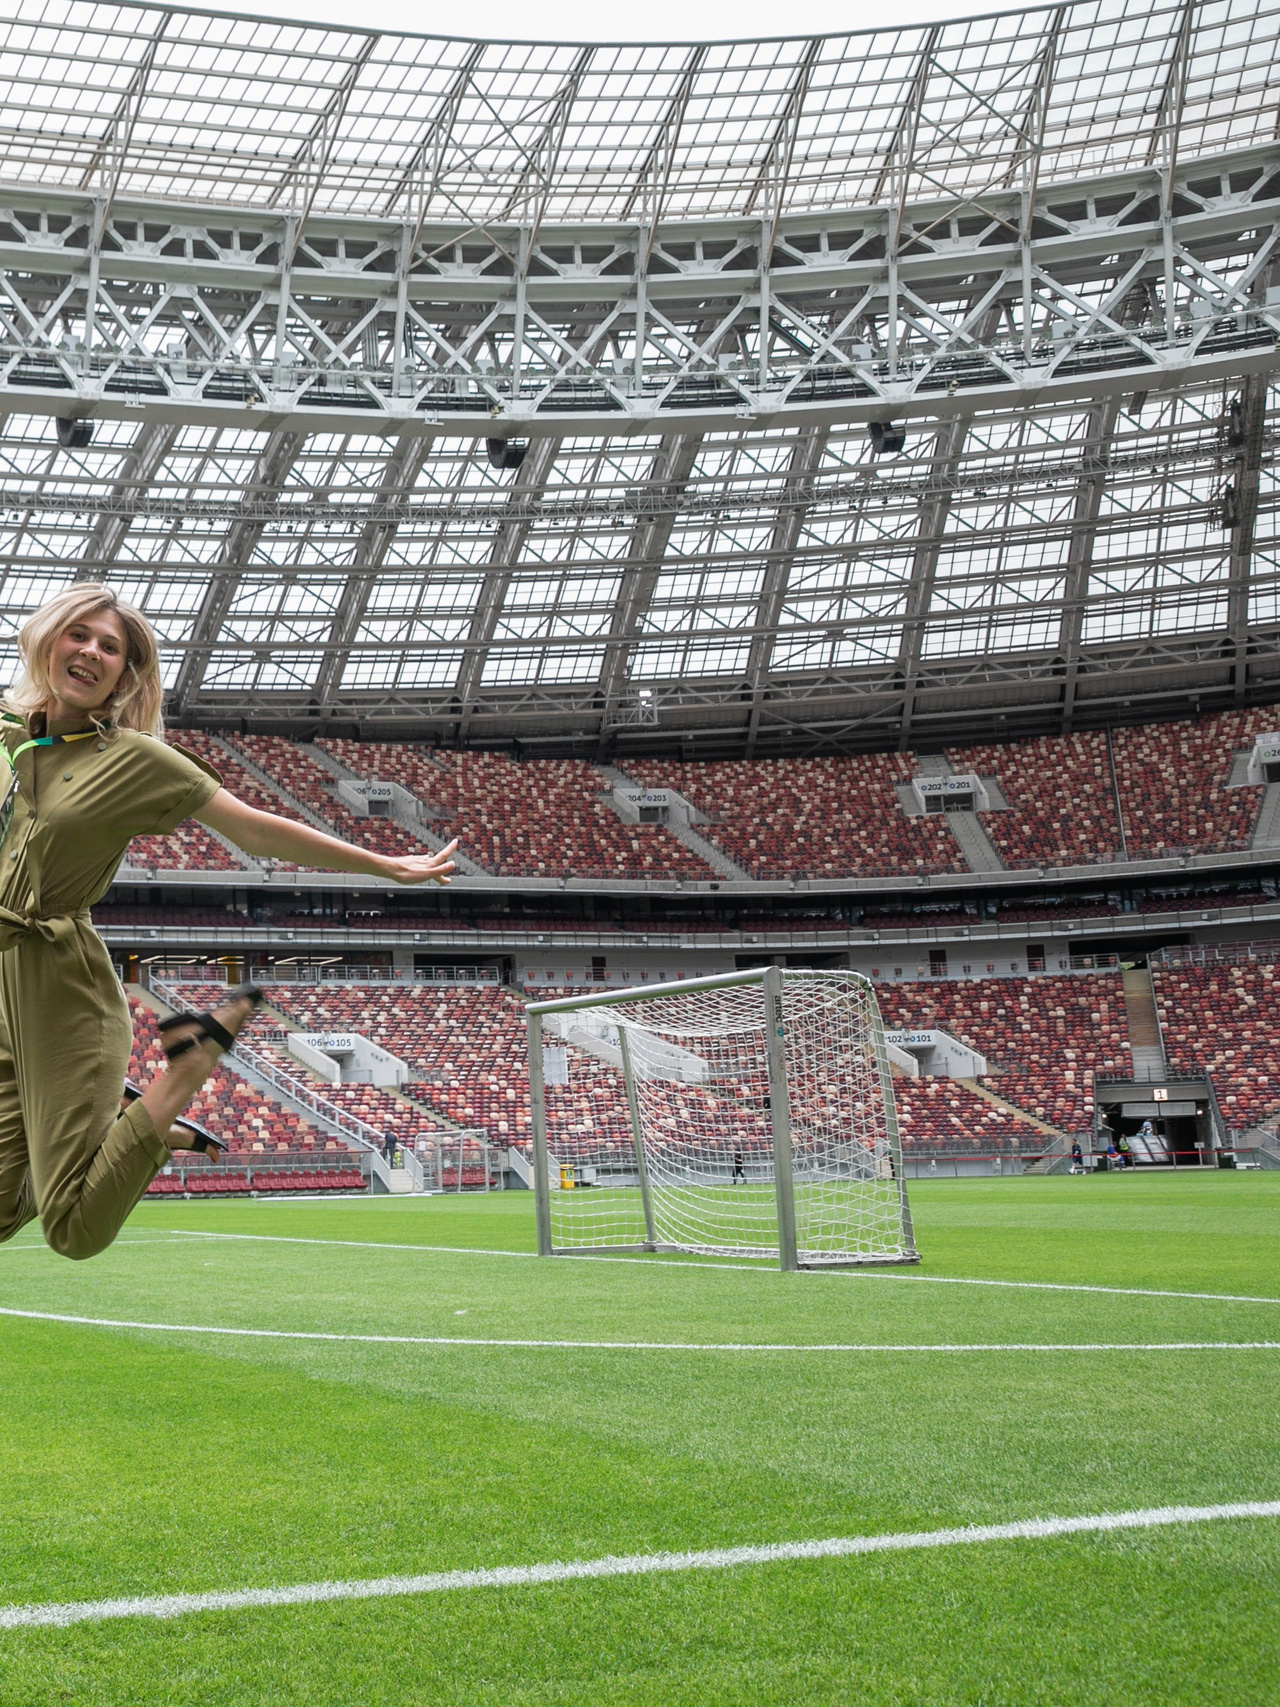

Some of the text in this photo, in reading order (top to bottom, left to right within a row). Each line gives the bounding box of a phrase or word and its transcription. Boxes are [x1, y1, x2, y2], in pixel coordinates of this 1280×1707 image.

[927, 781, 971, 791] 202 201
[377, 788, 391, 796] 205
[652, 794, 667, 802] 203
[774, 994, 783, 1024] artec
[306, 1038, 352, 1047] 106 105
[887, 1034, 932, 1043] 102 101
[1157, 1090, 1165, 1099] 1
